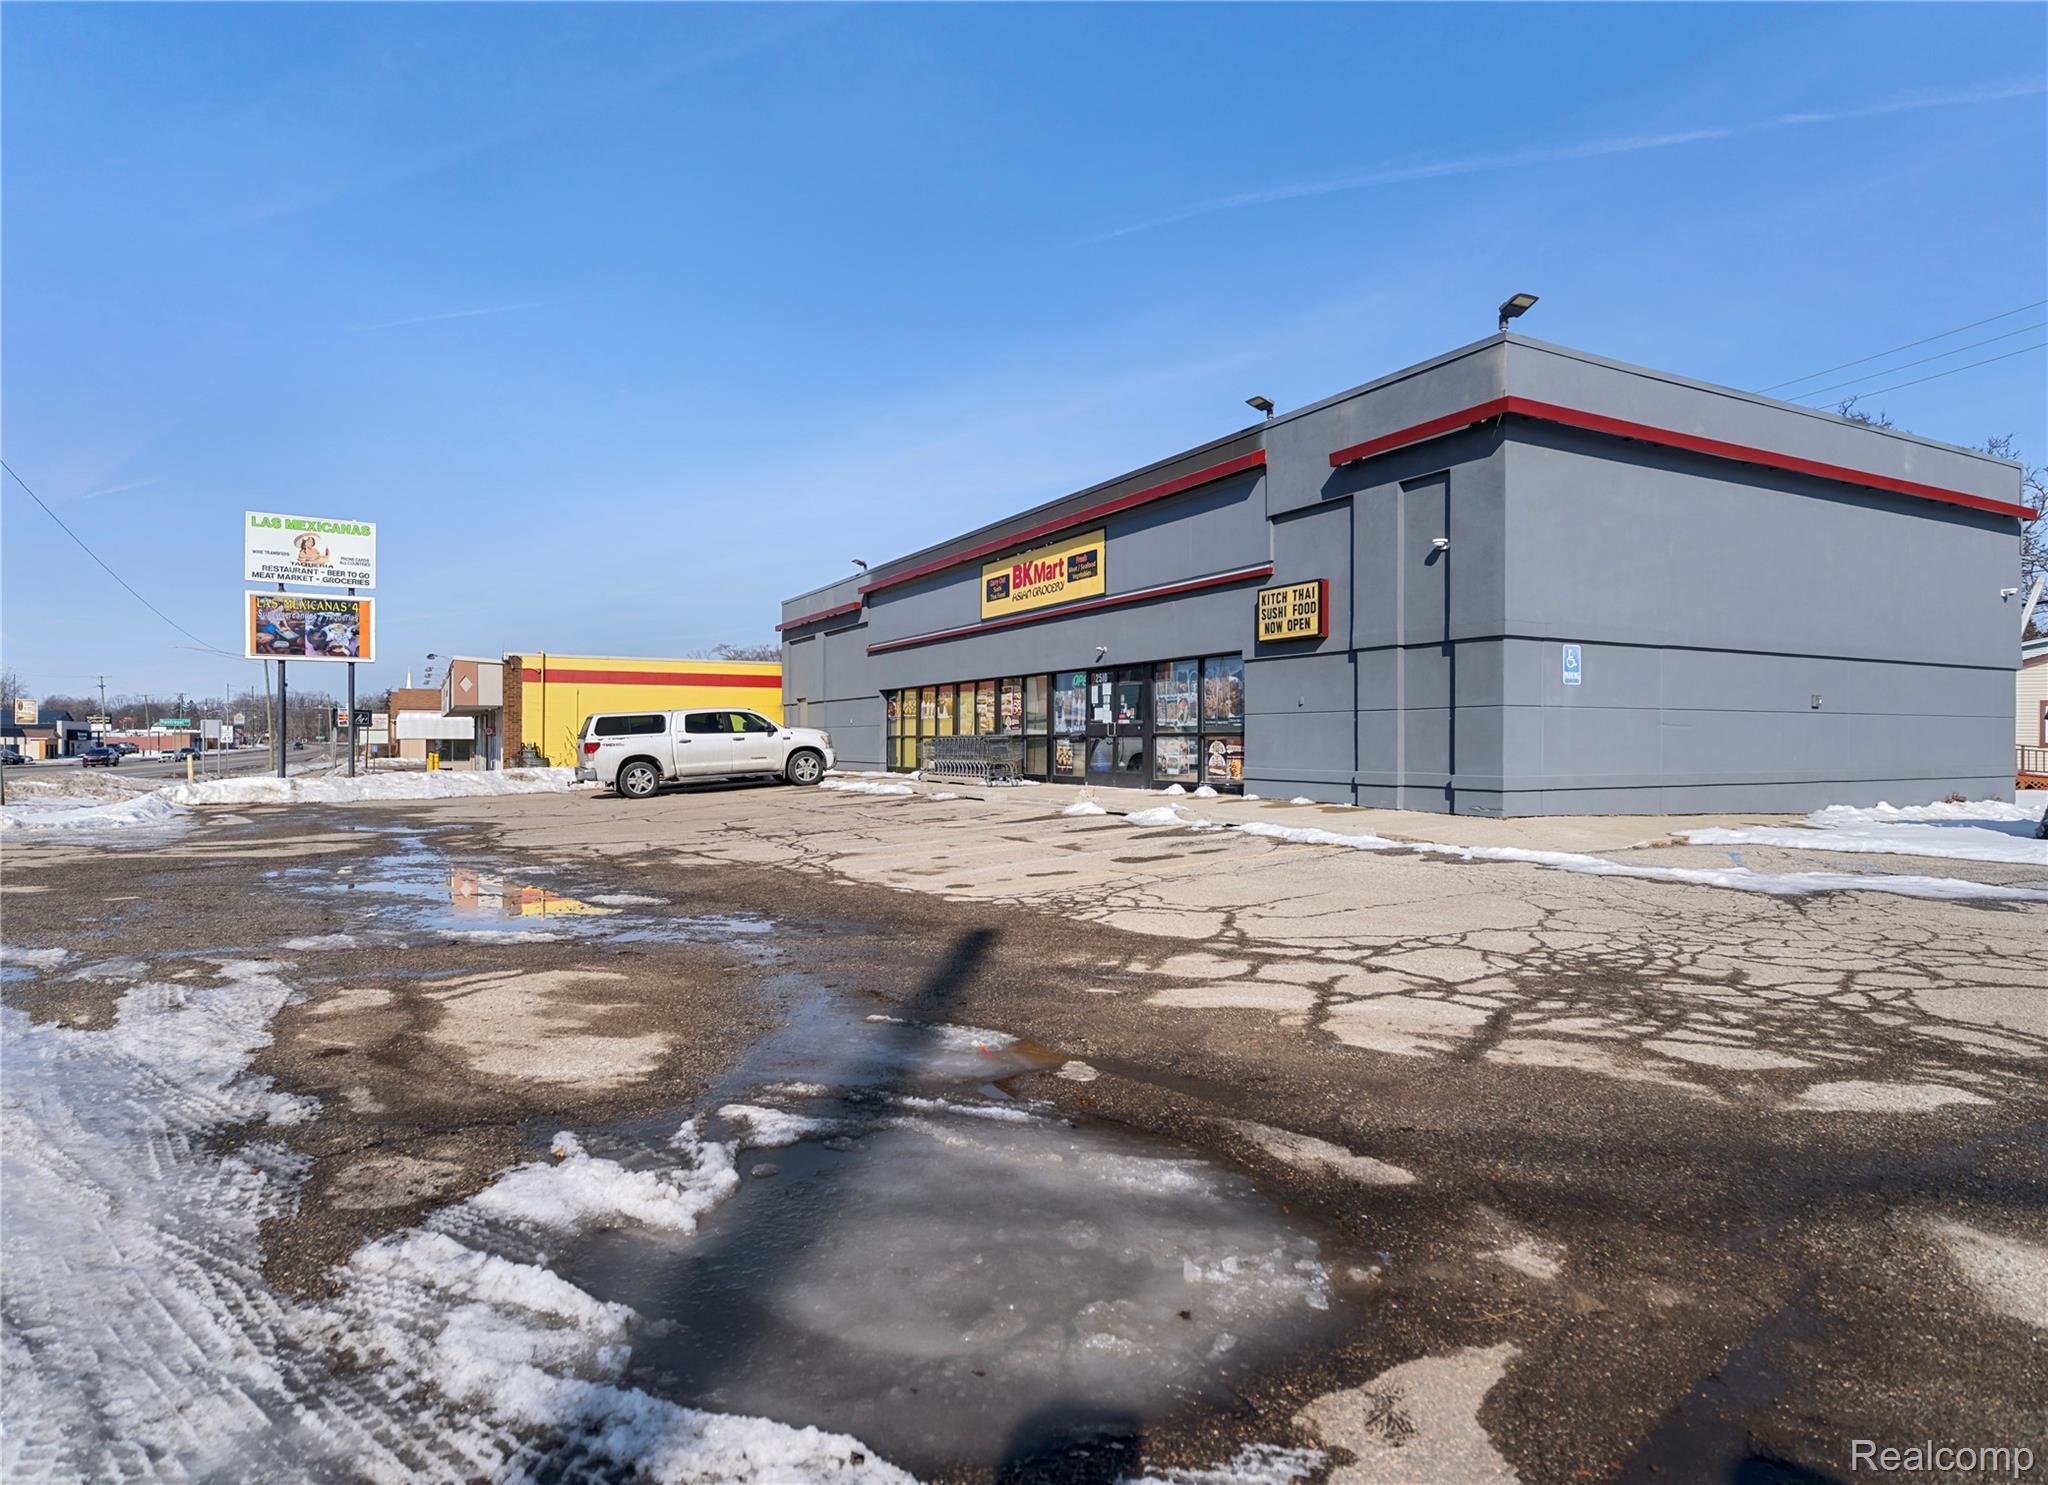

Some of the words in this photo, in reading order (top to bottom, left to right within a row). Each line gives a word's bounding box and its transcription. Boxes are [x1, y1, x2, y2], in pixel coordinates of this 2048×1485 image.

[251, 516, 281, 529] LAS
[285, 519, 371, 537] MEXICANAS
[262, 565, 319, 575] RESTAURANT
[327, 569, 346, 577] BEER
[1080, 560, 1097, 569] Seafood
[251, 571, 275, 579] MEAT
[277, 573, 314, 582] MARKET
[322, 576, 370, 586] GROCERIES
[1012, 588, 1032, 602] ASIAN
[1032, 581, 1065, 597] GROCERY
[1261, 591, 1288, 607] KITCH
[1292, 586, 1315, 602] THAI
[256, 597, 279, 609] LAS
[283, 598, 348, 613] MEXICANAS
[351, 602, 359, 614] 4
[1261, 605, 1287, 621] SUSHI
[1292, 601, 1316, 617] FOOD
[1264, 621, 1283, 634] NOW
[1287, 617, 1311, 632] OPEN
[1073, 672, 1087, 687] OPE
